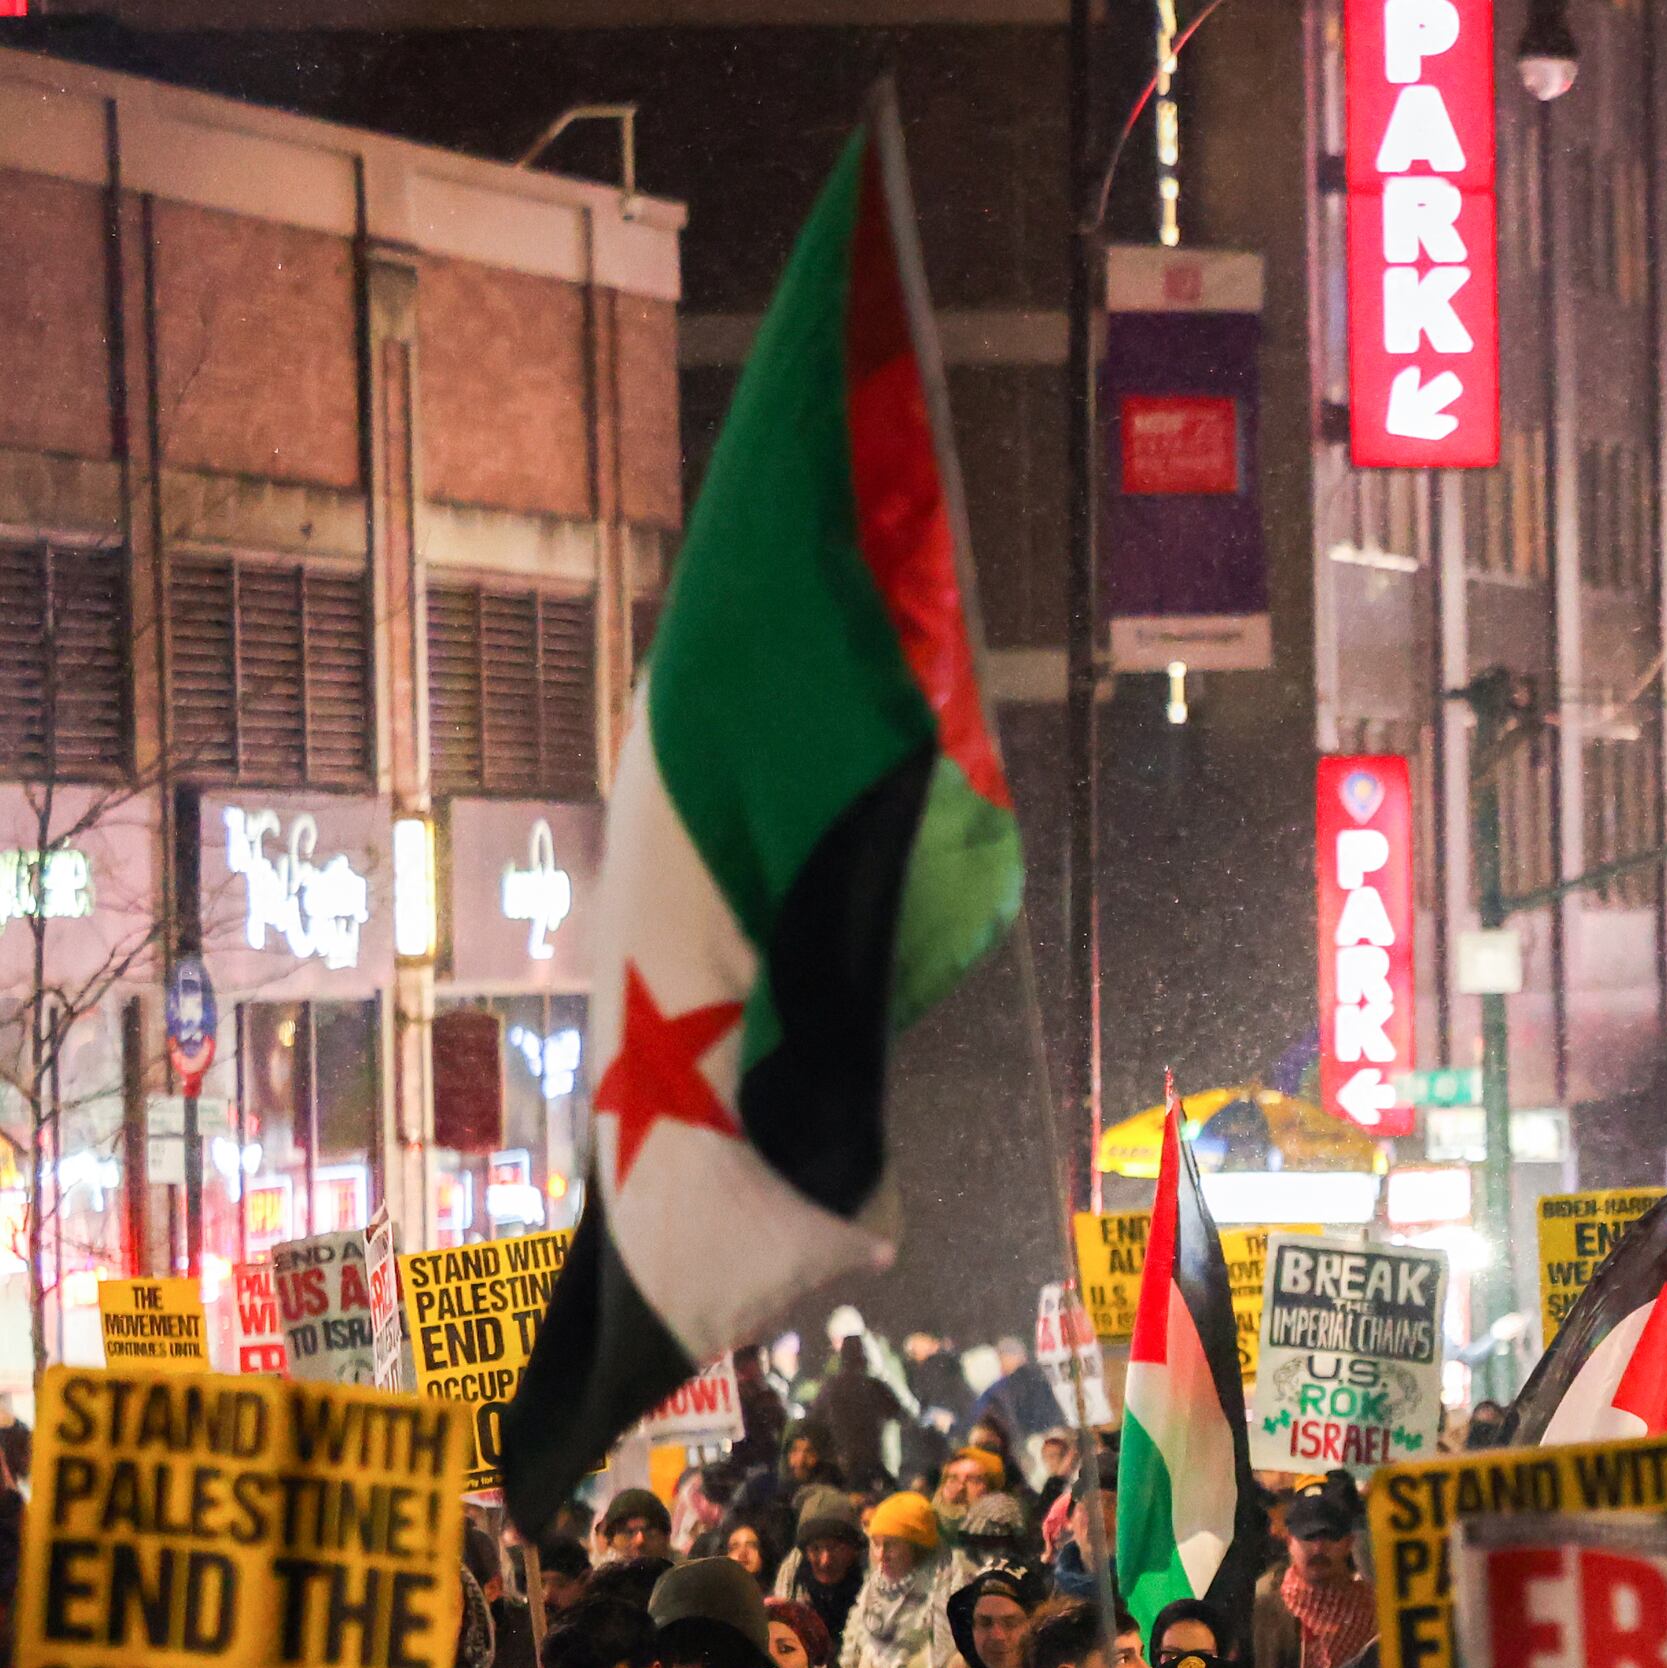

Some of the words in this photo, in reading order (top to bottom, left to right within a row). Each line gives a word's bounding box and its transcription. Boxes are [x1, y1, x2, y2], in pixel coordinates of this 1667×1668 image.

[1376, 0, 1474, 354] PARK
[1335, 829, 1397, 1062] PARK
[410, 1247, 500, 1288] STAND
[505, 1234, 568, 1273] WITH
[1575, 1221, 1628, 1256] EN
[132, 1286, 163, 1310] THE
[1280, 1250, 1431, 1306] BREAK
[105, 1313, 200, 1338] MOVEMENT
[1272, 1305, 1353, 1349] IMPERIAL
[1357, 1315, 1431, 1359] CHAINS
[1332, 1299, 1375, 1315] THE
[288, 1323, 319, 1359] TO
[420, 1317, 505, 1371] END
[1308, 1355, 1388, 1388] U.S.
[55, 1376, 270, 1459] STAND
[295, 1394, 449, 1476] WITH
[1300, 1384, 1390, 1421] ROK
[1290, 1420, 1396, 1464] ISRAEL
[53, 1456, 441, 1561] PALESTINE!
[1386, 1456, 1561, 1532] STAND
[45, 1540, 240, 1654] END
